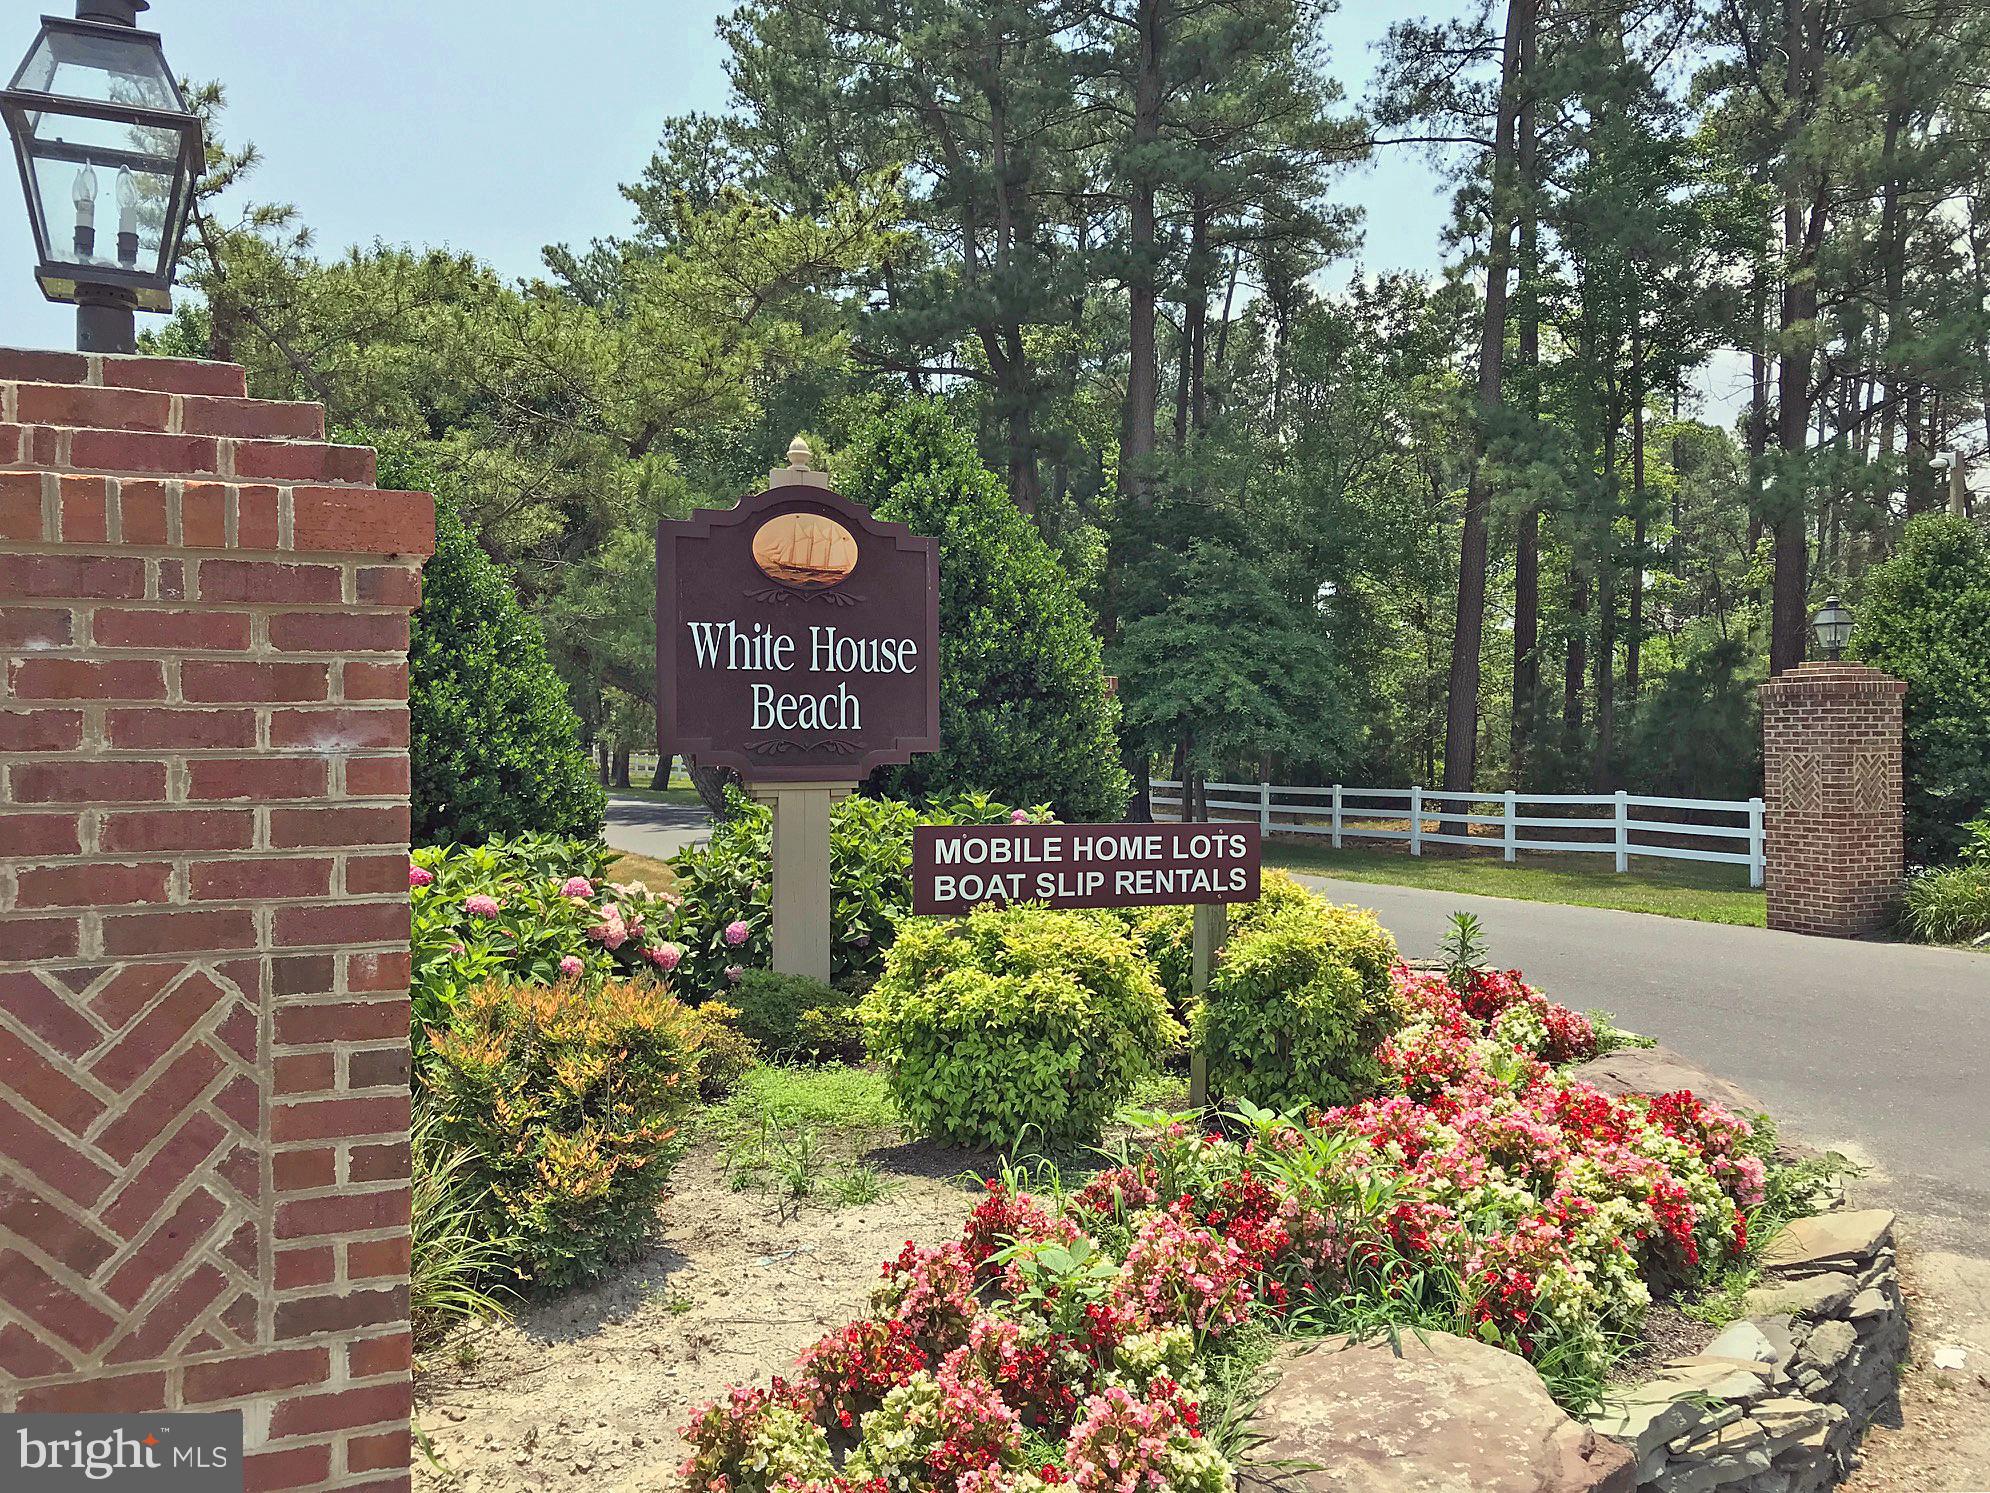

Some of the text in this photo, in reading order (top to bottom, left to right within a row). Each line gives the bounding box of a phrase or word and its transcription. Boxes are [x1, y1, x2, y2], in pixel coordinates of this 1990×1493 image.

[687, 620, 918, 674] White House
[750, 681, 862, 730] Beach
[935, 834, 1247, 865] MOBILE HOME LOTS
[934, 867, 1247, 902] BOAT SLIP RENTALS
